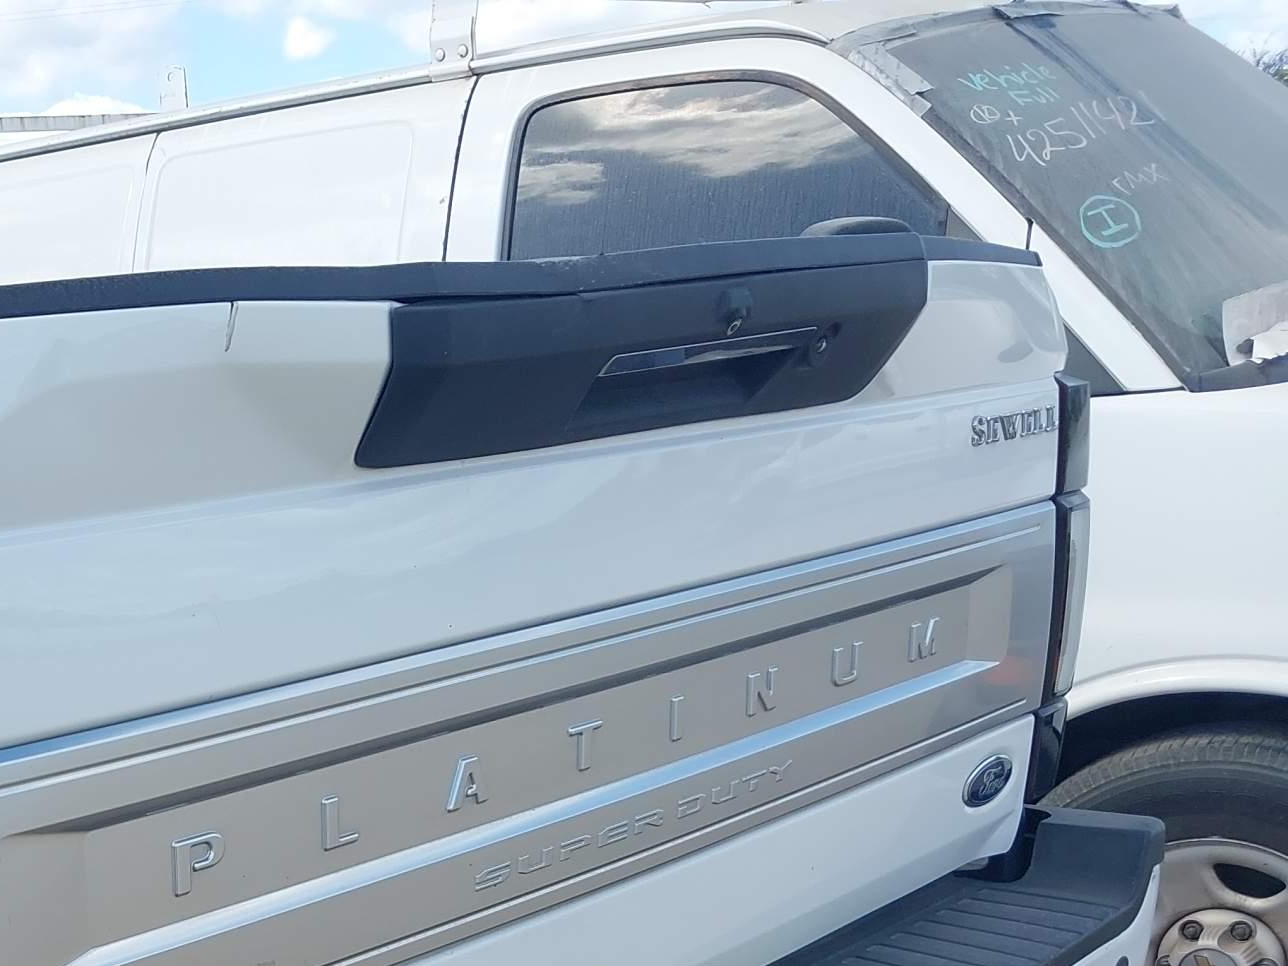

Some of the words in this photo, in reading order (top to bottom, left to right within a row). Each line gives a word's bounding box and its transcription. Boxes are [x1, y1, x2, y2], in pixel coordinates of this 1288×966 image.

[958, 63, 1056, 91] Vehicle
[971, 405, 1058, 447] SEWELL
[170, 616, 940, 897] PLATINUM
[474, 808, 664, 891] SUPER
[678, 759, 793, 819] DUTY
